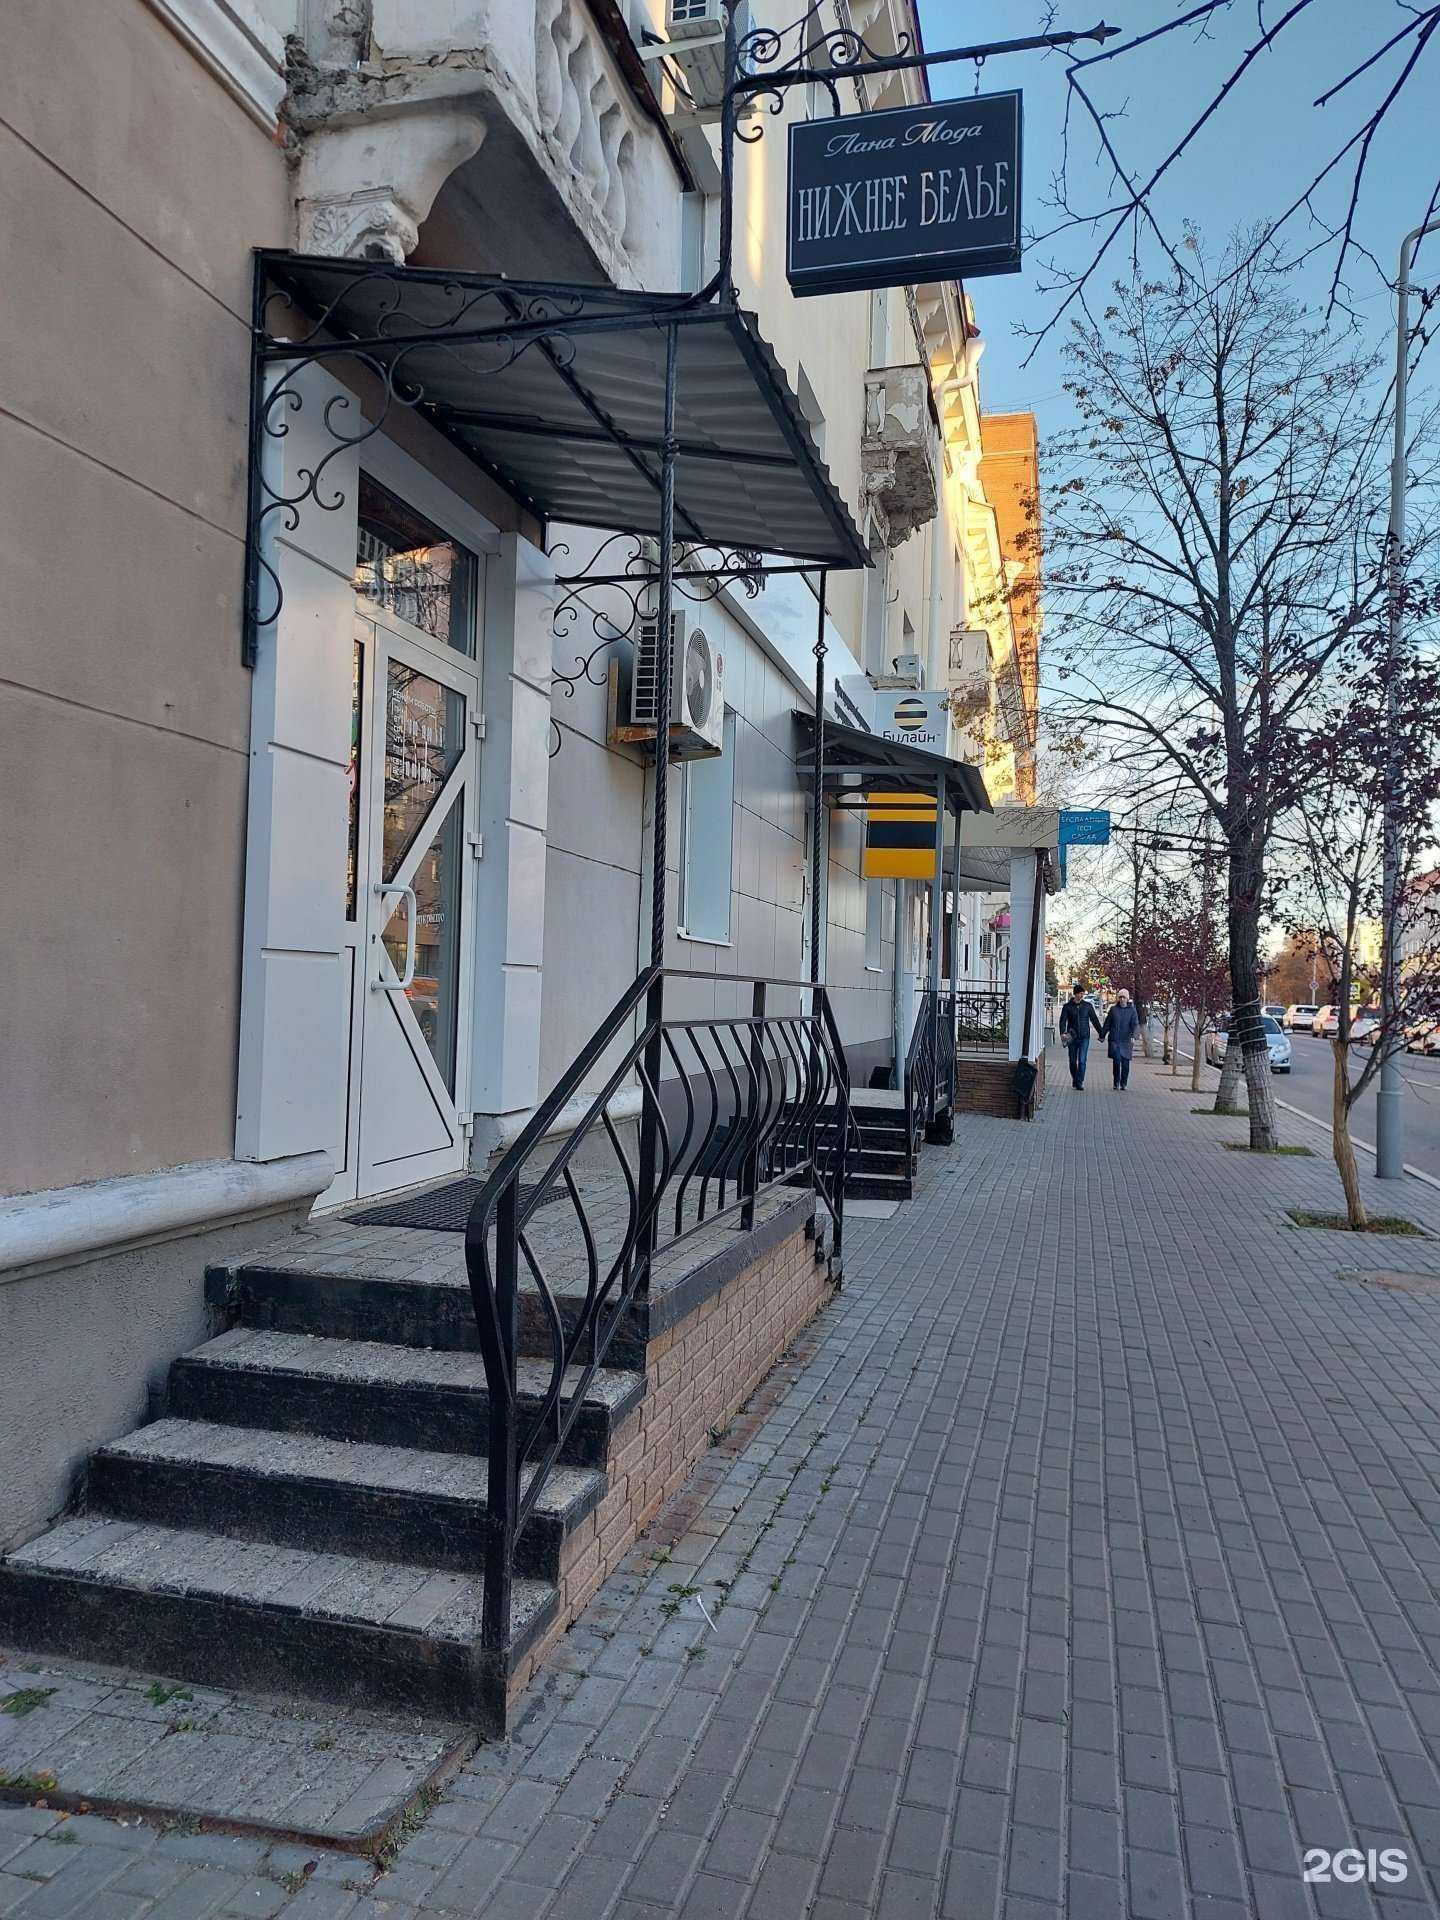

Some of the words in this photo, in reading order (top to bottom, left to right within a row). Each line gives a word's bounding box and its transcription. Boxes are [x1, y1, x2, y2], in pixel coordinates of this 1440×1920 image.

[824, 132, 897, 157] Лана
[902, 119, 983, 146] Мода
[798, 175, 908, 242] НИЖНЕЕ
[919, 161, 1009, 227] БЕЛЬЕ
